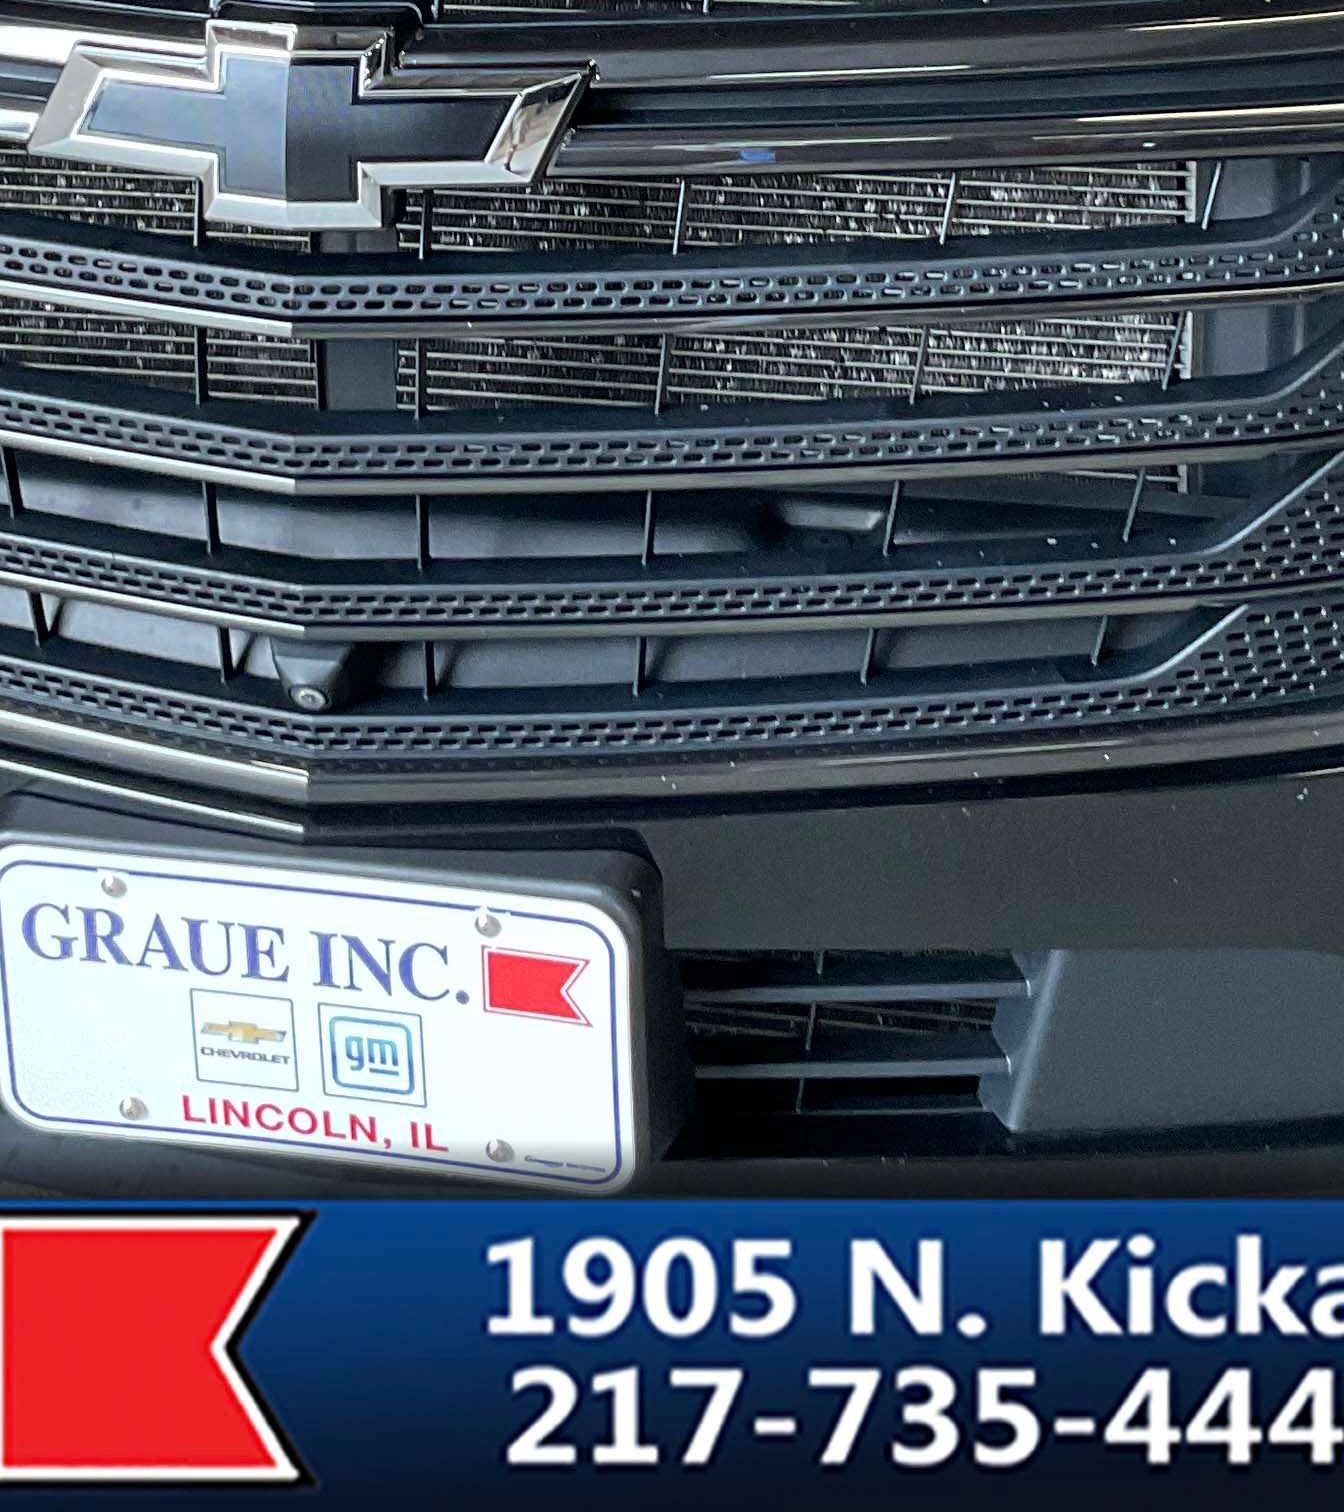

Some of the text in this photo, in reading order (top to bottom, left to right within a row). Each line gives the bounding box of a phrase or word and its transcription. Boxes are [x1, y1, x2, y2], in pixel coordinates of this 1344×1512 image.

[21, 903, 470, 1005] GRAUE INC.
[200, 1046, 290, 1065] CHEVROLET
[345, 1035, 400, 1071] gm
[182, 1094, 449, 1153] LINCOLN, IL
